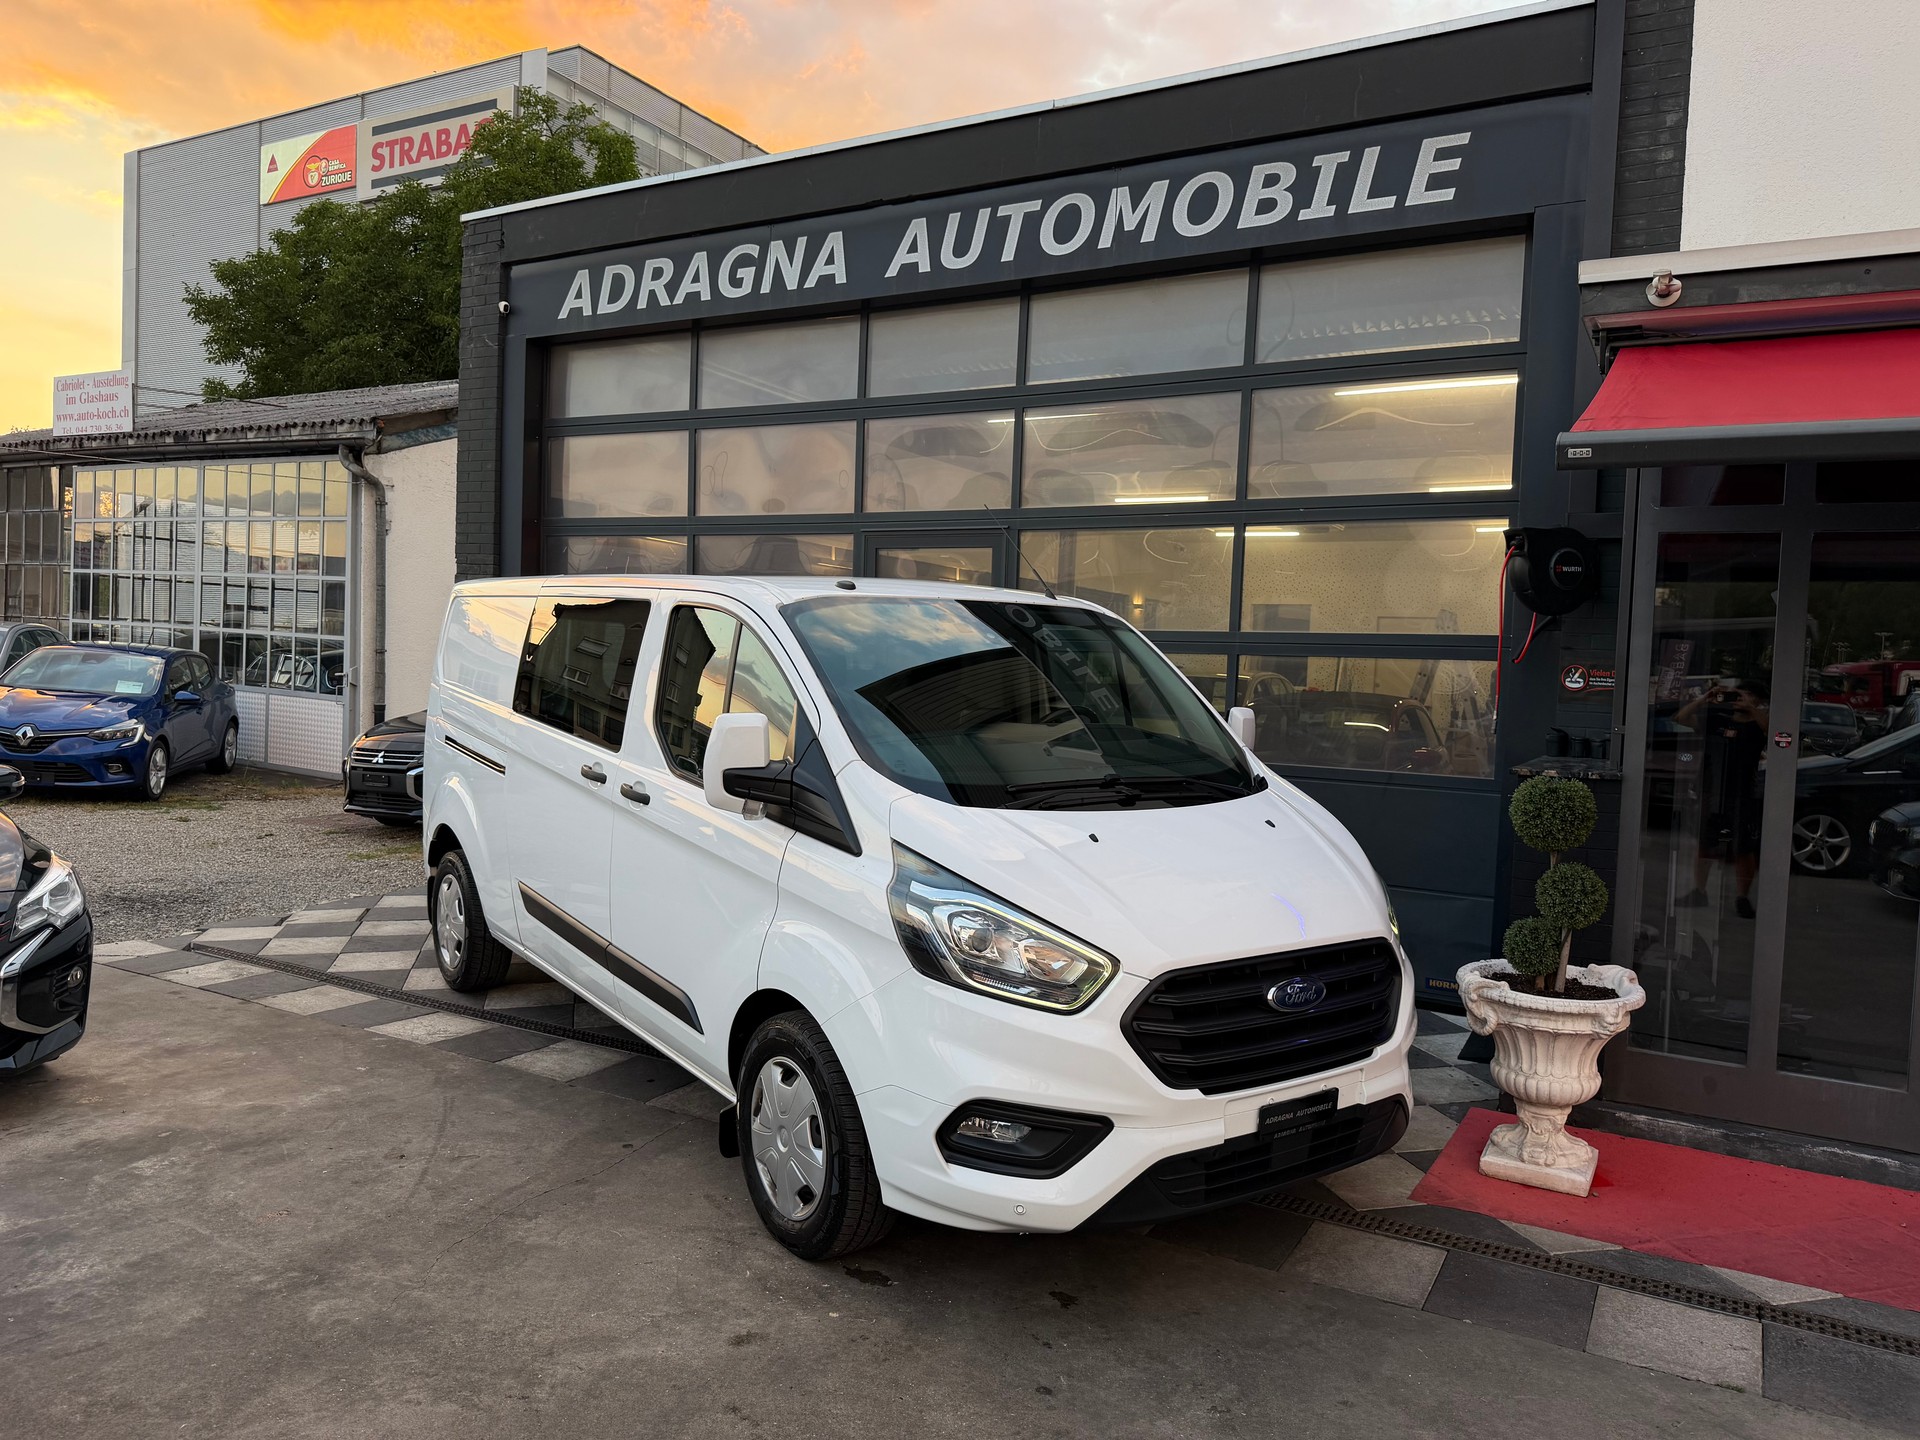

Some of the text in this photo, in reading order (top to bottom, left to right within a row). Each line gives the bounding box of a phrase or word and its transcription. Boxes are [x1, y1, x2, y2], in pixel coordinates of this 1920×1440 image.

[371, 117, 494, 173] STRABA
[321, 171, 352, 186] ZURIQUE
[557, 131, 1472, 320] ADRAGNA AUTOMOBILE
[56, 378, 85, 392] Cabriolet
[92, 374, 129, 389] Ausstellung
[65, 391, 119, 405] im Glashaus
[56, 405, 129, 422] www.auto-koch.ch
[90, 425, 102, 433] 730
[104, 424, 113, 432] 36
[115, 423, 124, 431] 36
[1429, 979, 1459, 990] HORM
[1285, 983, 1317, 1005] Ford
[1265, 1101, 1333, 1125] ADRAGNA AUTOMOBILE
